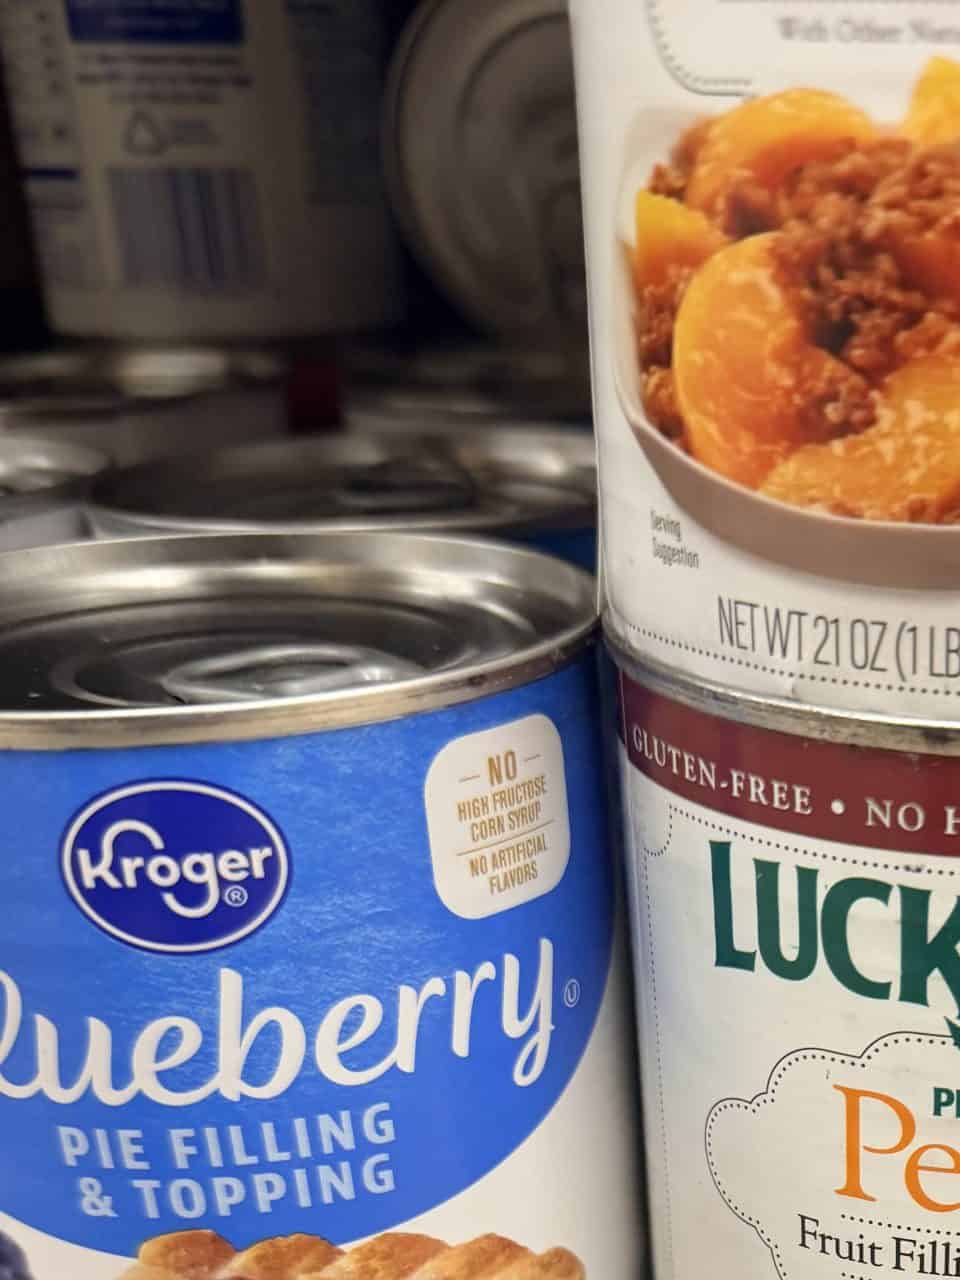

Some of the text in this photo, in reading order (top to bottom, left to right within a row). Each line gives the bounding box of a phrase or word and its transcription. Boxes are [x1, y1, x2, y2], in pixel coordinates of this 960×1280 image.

[717, 594, 758, 652] NET
[763, 605, 808, 661] WT
[813, 615, 841, 667] 21
[850, 619, 888, 673] OZ
[894, 620, 919, 682] (1
[487, 750, 518, 787] NO
[632, 723, 813, 815] GLUTEN-FREE
[864, 797, 925, 832] NO
[457, 775, 549, 822] HIGH FRUCTOSE
[470, 800, 541, 843] CORN SYRUP
[76, 819, 274, 919] Kroger
[469, 833, 549, 878] NO ARTIFICIAL
[488, 861, 540, 896] FLAVORS
[55, 1101, 398, 1171] PIE FILLING
[78, 1152, 398, 1219] & TOPPING
[797, 1213, 885, 1268] Fruit
